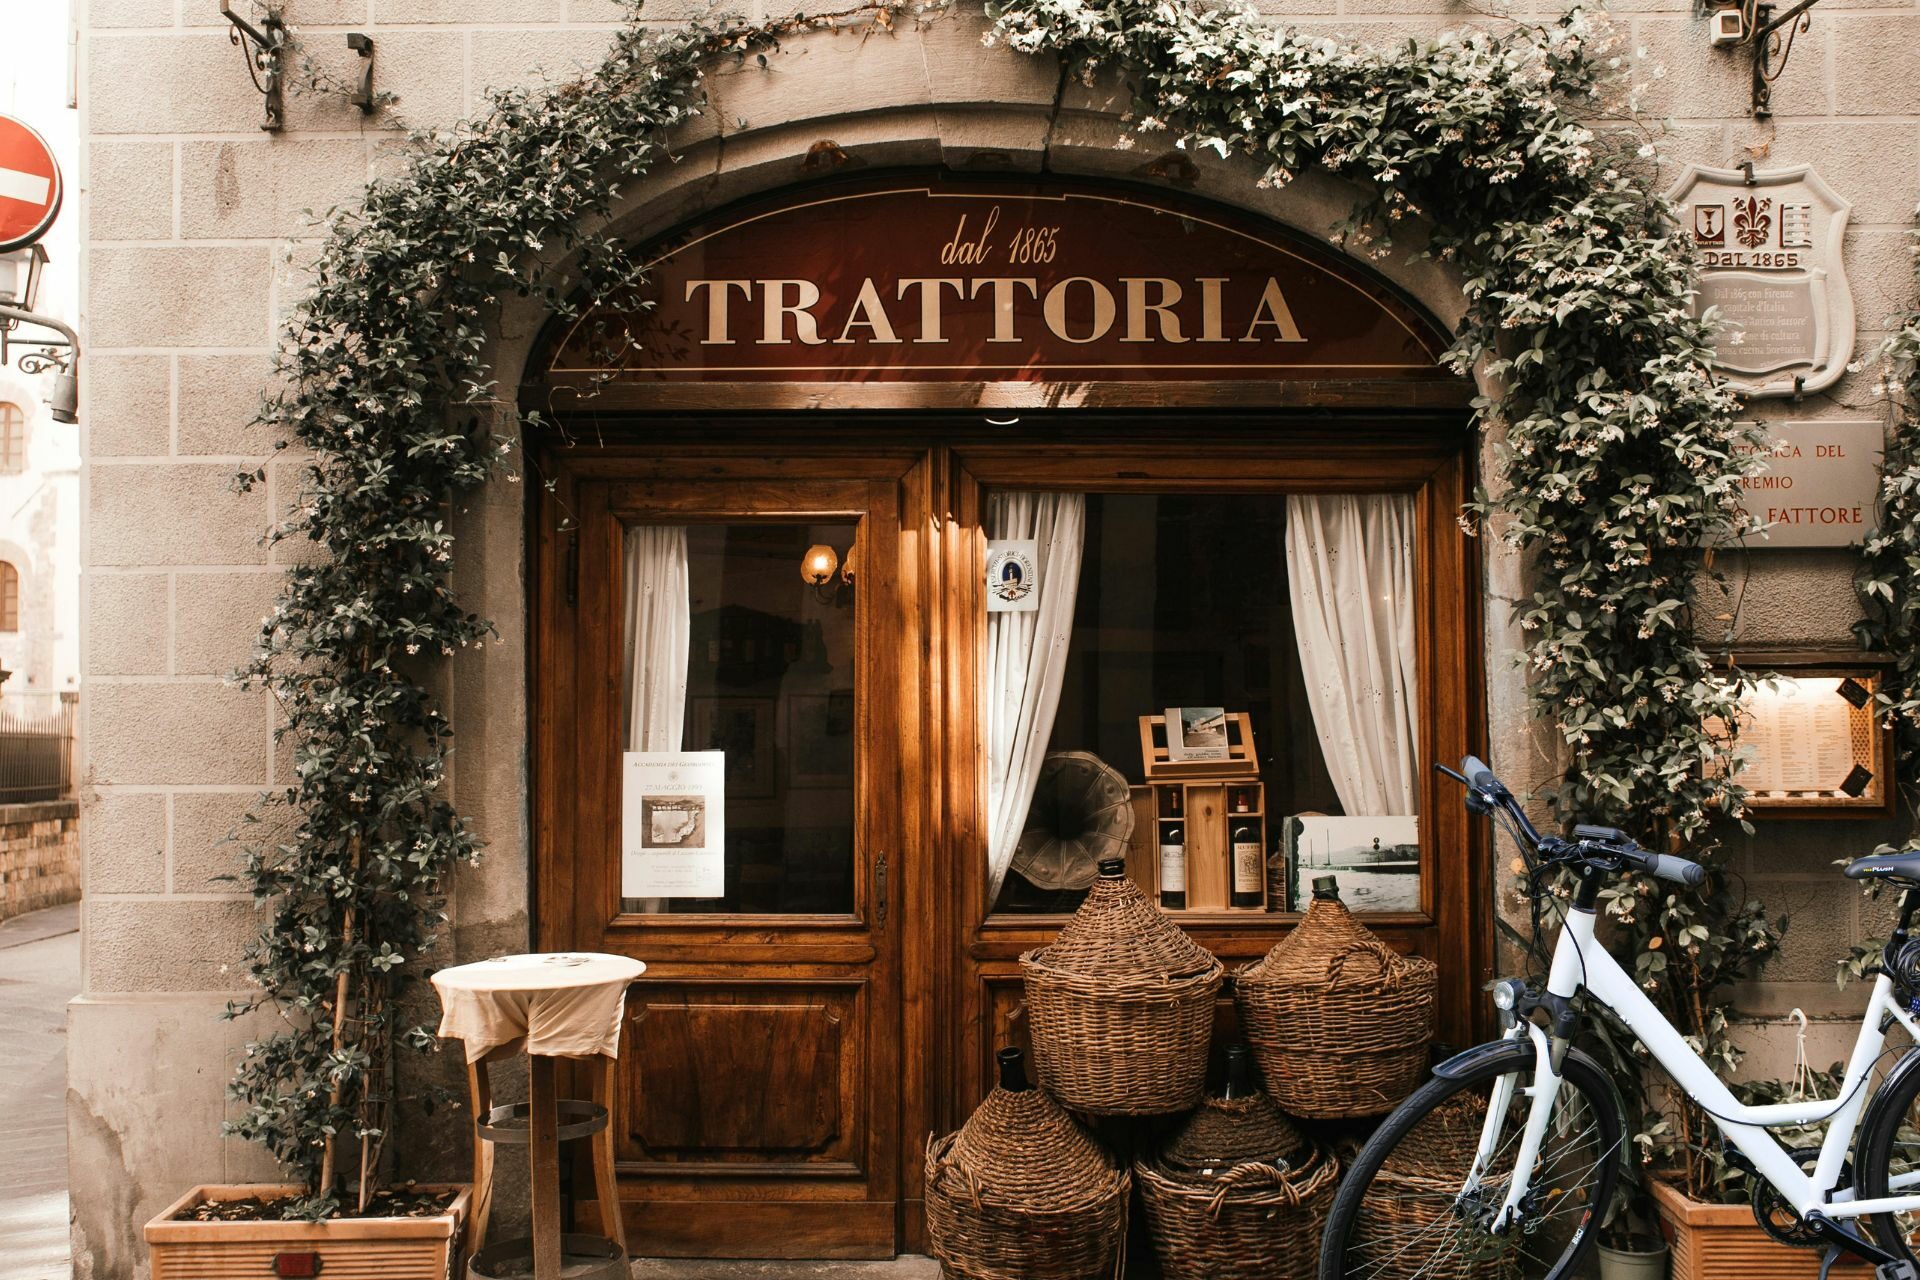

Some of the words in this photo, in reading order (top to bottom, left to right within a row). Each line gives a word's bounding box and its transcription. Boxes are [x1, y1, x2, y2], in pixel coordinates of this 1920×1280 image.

[941, 205, 1000, 265] dal
[1009, 227, 1060, 264] 1865
[1751, 252, 1798, 267] 1865
[685, 277, 1308, 345] TRATTORIA
[1815, 445, 1846, 458] DEL
[1768, 507, 1863, 524] FATTORE
